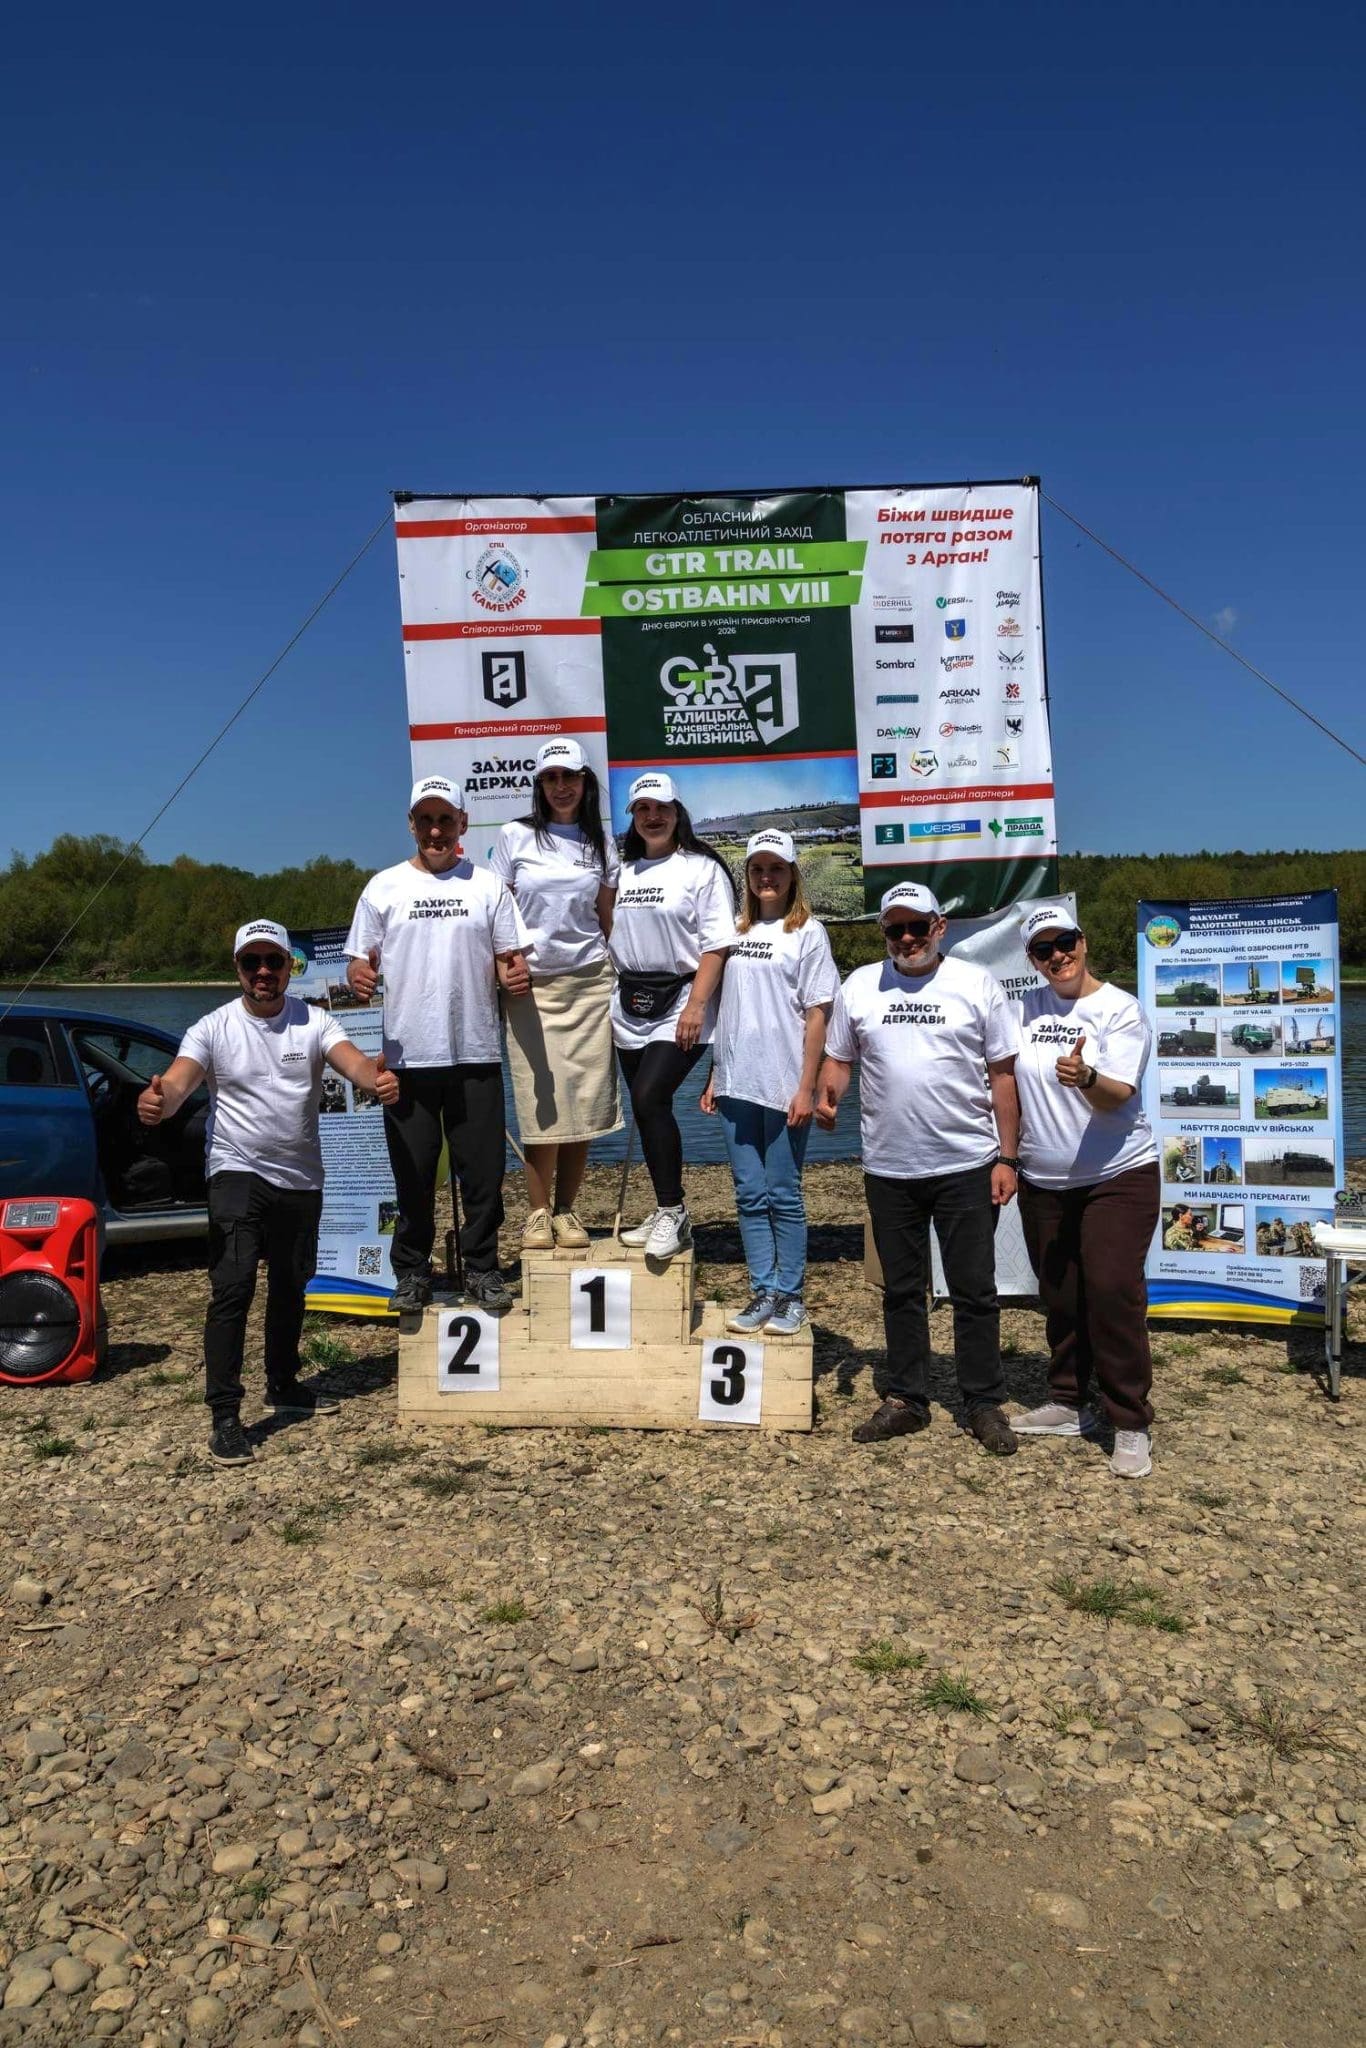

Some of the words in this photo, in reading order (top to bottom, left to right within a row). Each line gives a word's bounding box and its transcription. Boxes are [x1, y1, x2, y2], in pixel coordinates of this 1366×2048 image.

[682, 511, 762, 525] ОБЛАСНИЙ
[877, 507, 926, 522] Біжи
[931, 508, 1014, 522] швидше
[465, 521, 527, 532] Організатор
[633, 526, 770, 544] ЛЕГКОАТЛЕТИЧНИЙ
[774, 526, 813, 540] ЗАХІД
[880, 531, 945, 544] потяга
[951, 529, 1013, 546] разом
[646, 552, 706, 576] GTR
[714, 548, 804, 573] TRAIL
[906, 553, 916, 565] з
[921, 549, 989, 568] Артан!
[472, 588, 527, 612] КАМЕНЯР
[621, 586, 770, 612] OSTBAHN
[782, 581, 829, 605] VIII
[461, 622, 542, 635] Співорганізатор
[641, 622, 663, 632] ДНЮ
[664, 620, 699, 630] ЄВРОПИ
[708, 617, 739, 627] УКРАЇНІ
[741, 615, 810, 625] ПРИСВЯЧУЄТЬСЯ
[718, 627, 736, 635] 2026
[876, 659, 914, 670] Sombra
[939, 688, 980, 699] ARKAN
[944, 697, 975, 705] ARENA
[664, 709, 749, 725] ГАЛИЦЬКА
[454, 724, 518, 736] Генеральний
[520, 723, 561, 734] партнер
[665, 723, 753, 734] ТРАНСВЕРСАЛЬНА
[665, 730, 758, 746] ЗАЛІЗНИЦЯ
[472, 759, 537, 774] ЗАХИС
[465, 775, 536, 792] ДЕРЖА
[900, 790, 966, 803] Інформаційні
[969, 789, 1014, 800] партнери
[623, 888, 664, 896] ЗАХИСТ
[413, 899, 463, 908] ЗАХИСТ
[616, 895, 665, 906] ДЕРЖАВИ
[409, 909, 469, 920] ДЕРЖАВИ
[1189, 913, 1240, 921] ФАКУЛЬТЕТ
[739, 941, 773, 950] АХИСТ
[1180, 945, 1245, 954] РАДІОЛОКАЦІЙНЕ
[1000, 975, 1038, 989] ЗПЕКИ
[889, 1003, 942, 1013] ЗАХИСТ
[882, 1014, 946, 1025] ДЕРЖАВИ
[1038, 1024, 1083, 1036] ЗАХИСТ
[1031, 1033, 1077, 1045] ДЕРЖАВ
[1181, 1124, 1219, 1132] НАБУТТЯ
[1221, 1124, 1260, 1133] ДОСВІДУ
[1269, 1123, 1314, 1133] ВІЙСЬКАХ
[1184, 1191, 1198, 1199] МИ
[1199, 1191, 1248, 1200] НАВЧАЄМО
[1250, 1193, 1310, 1202] ПЕРЕМАГАТИ!
[580, 1276, 606, 1333] 1
[447, 1316, 481, 1375] 2
[710, 1346, 746, 1406] 3
